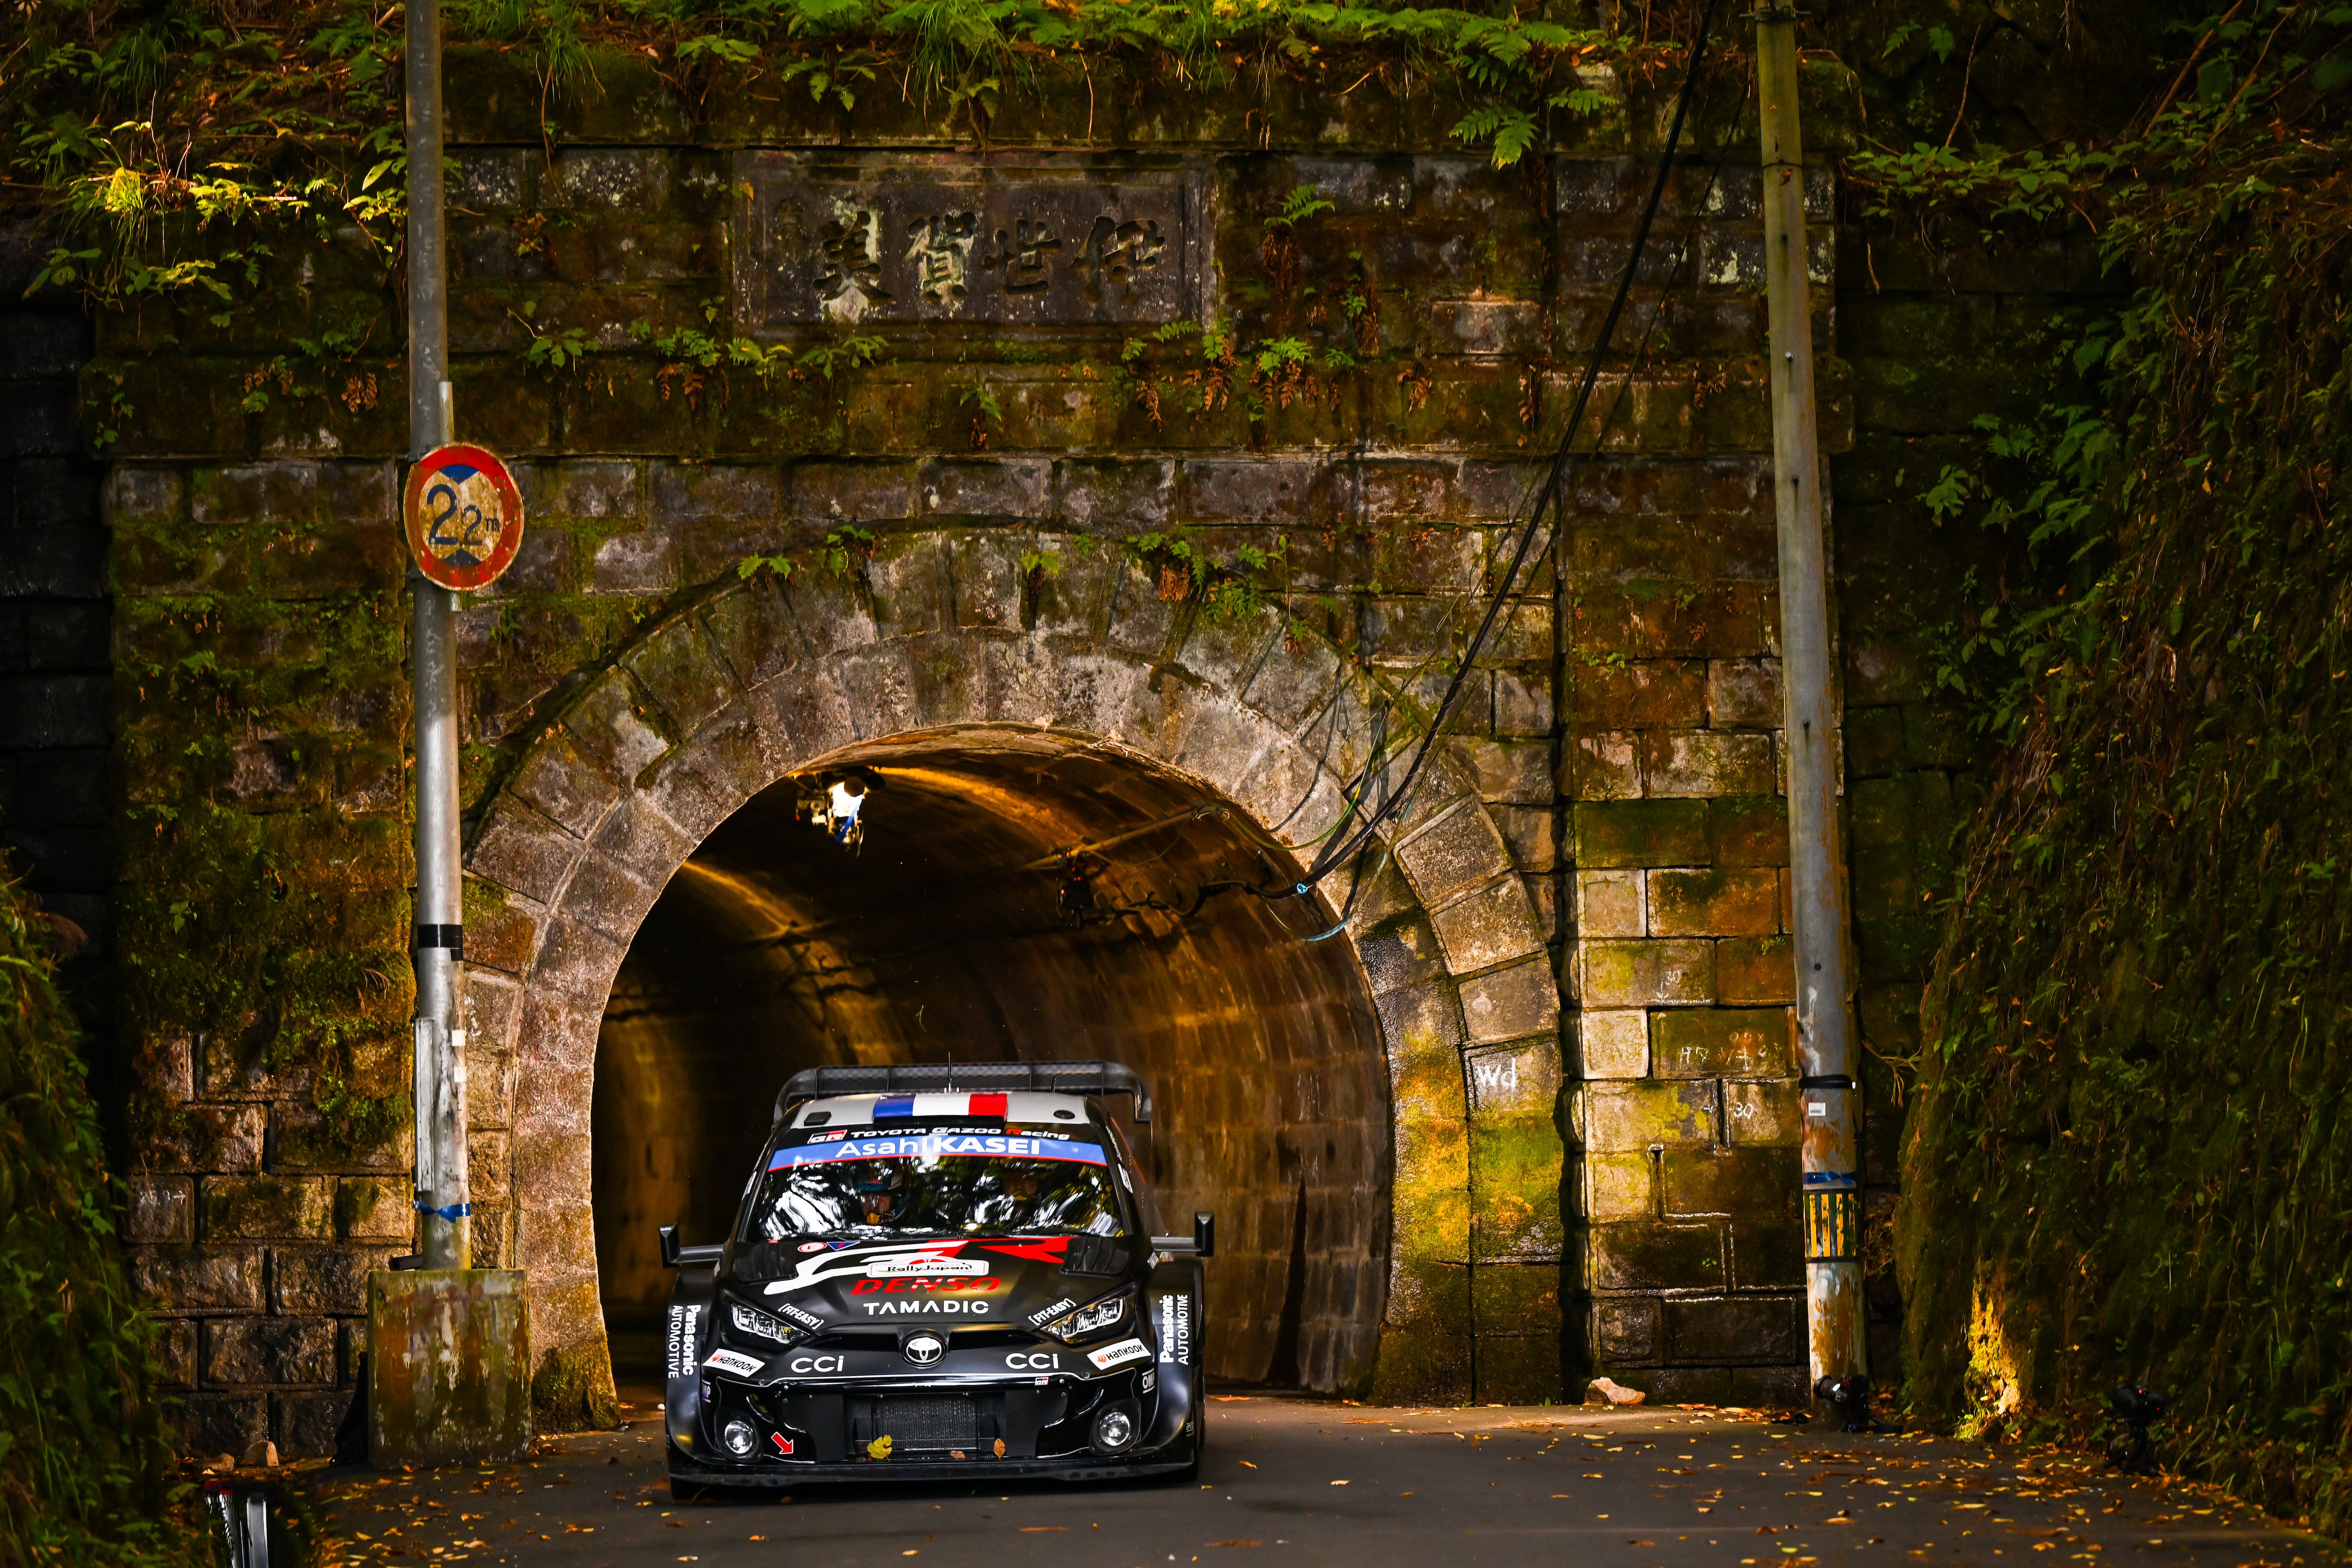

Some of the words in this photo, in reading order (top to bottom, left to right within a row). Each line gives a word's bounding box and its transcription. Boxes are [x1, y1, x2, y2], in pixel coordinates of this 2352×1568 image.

[851, 1128, 926, 1138] TOYOTA
[1006, 1129, 1070, 1140] Racing
[851, 1277, 1001, 1294] DENSO
[863, 1300, 988, 1315] TAMADIC
[668, 1305, 683, 1378] AUTOMOTIVE
[683, 1305, 701, 1376] Panasonic
[1159, 1295, 1174, 1363] Panasonic
[1177, 1294, 1189, 1365] AUTOMOTIVE
